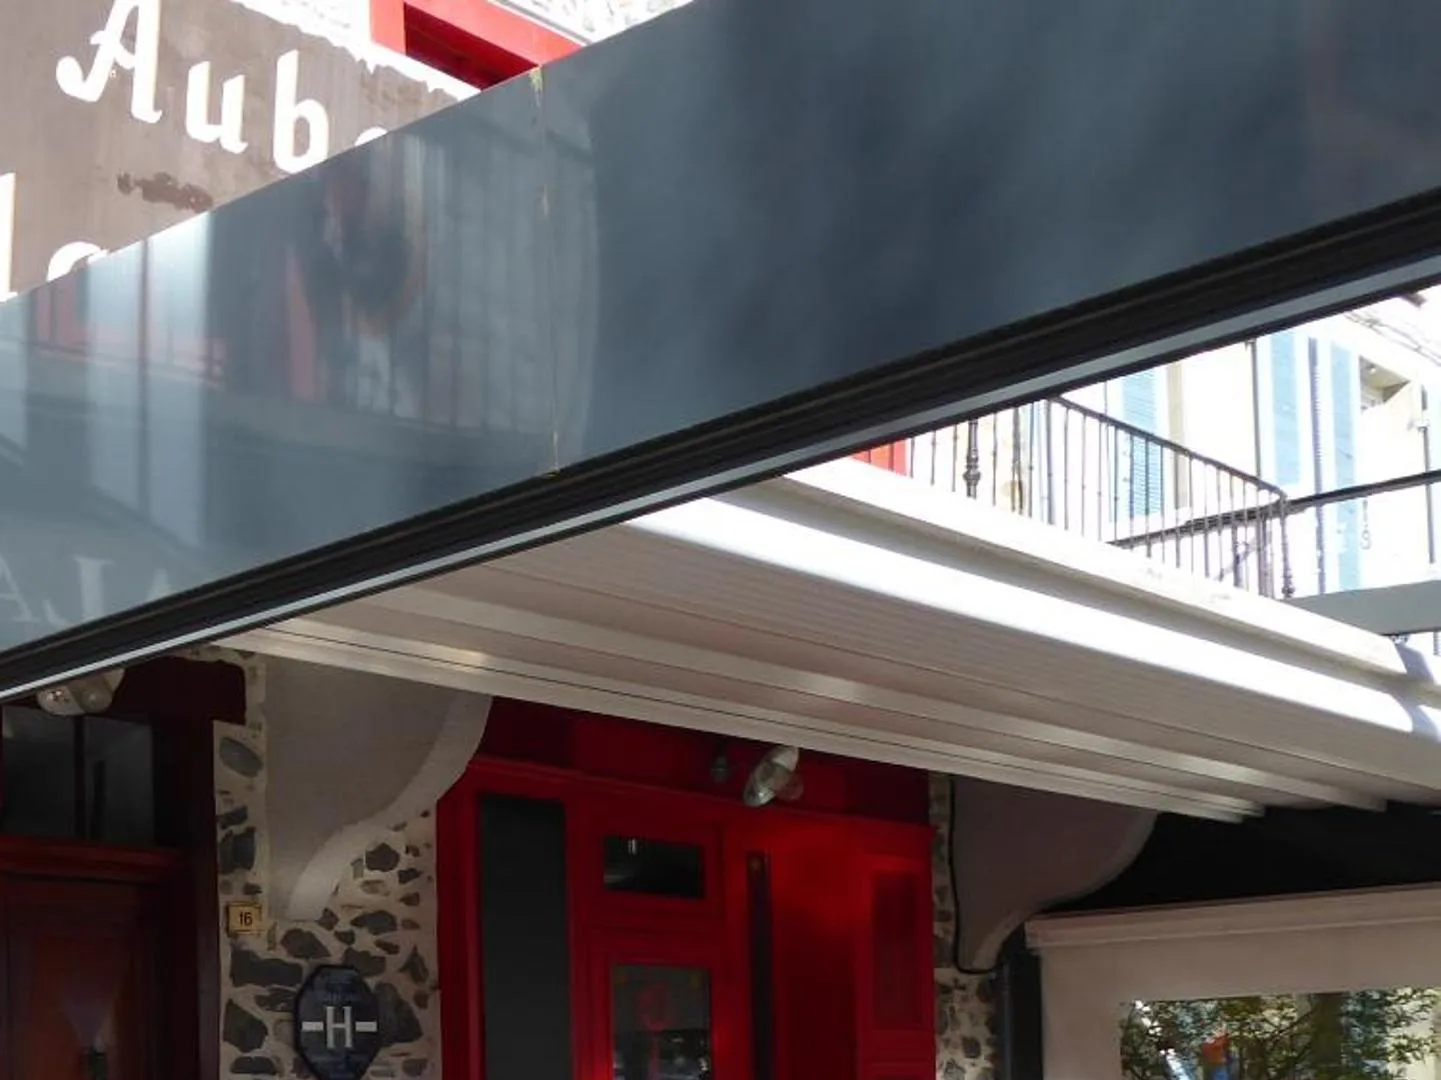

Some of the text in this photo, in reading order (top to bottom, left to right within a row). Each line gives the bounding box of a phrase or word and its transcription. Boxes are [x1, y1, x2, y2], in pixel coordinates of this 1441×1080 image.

[56, 0, 388, 172] Aub
[239, 911, 253, 927] 16
[326, 1005, 354, 1049] H
